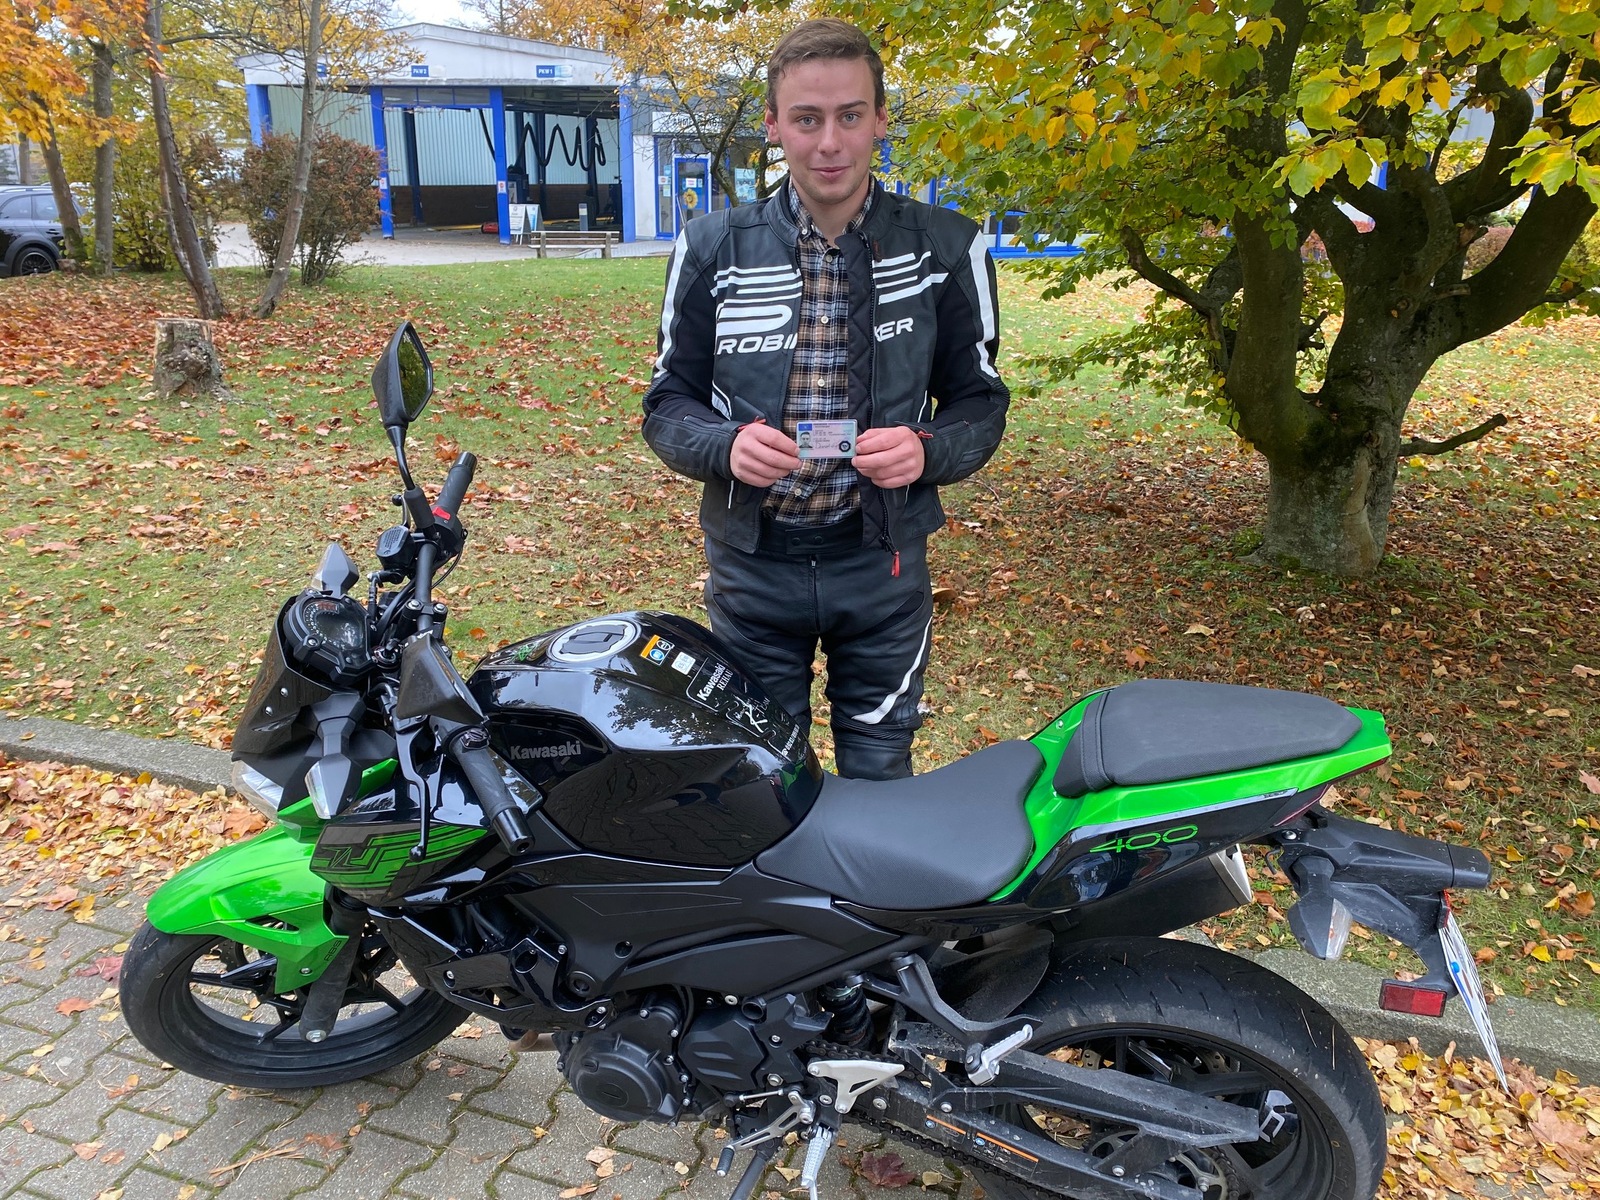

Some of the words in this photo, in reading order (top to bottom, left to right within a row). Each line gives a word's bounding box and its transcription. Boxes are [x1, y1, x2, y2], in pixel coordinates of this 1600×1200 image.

[696, 662, 727, 701] Kawasaki
[716, 668, 734, 691] REHAU
[510, 740, 582, 761] Kawasaki
[1089, 823, 1199, 853] 400
[323, 940, 342, 962] ABS
